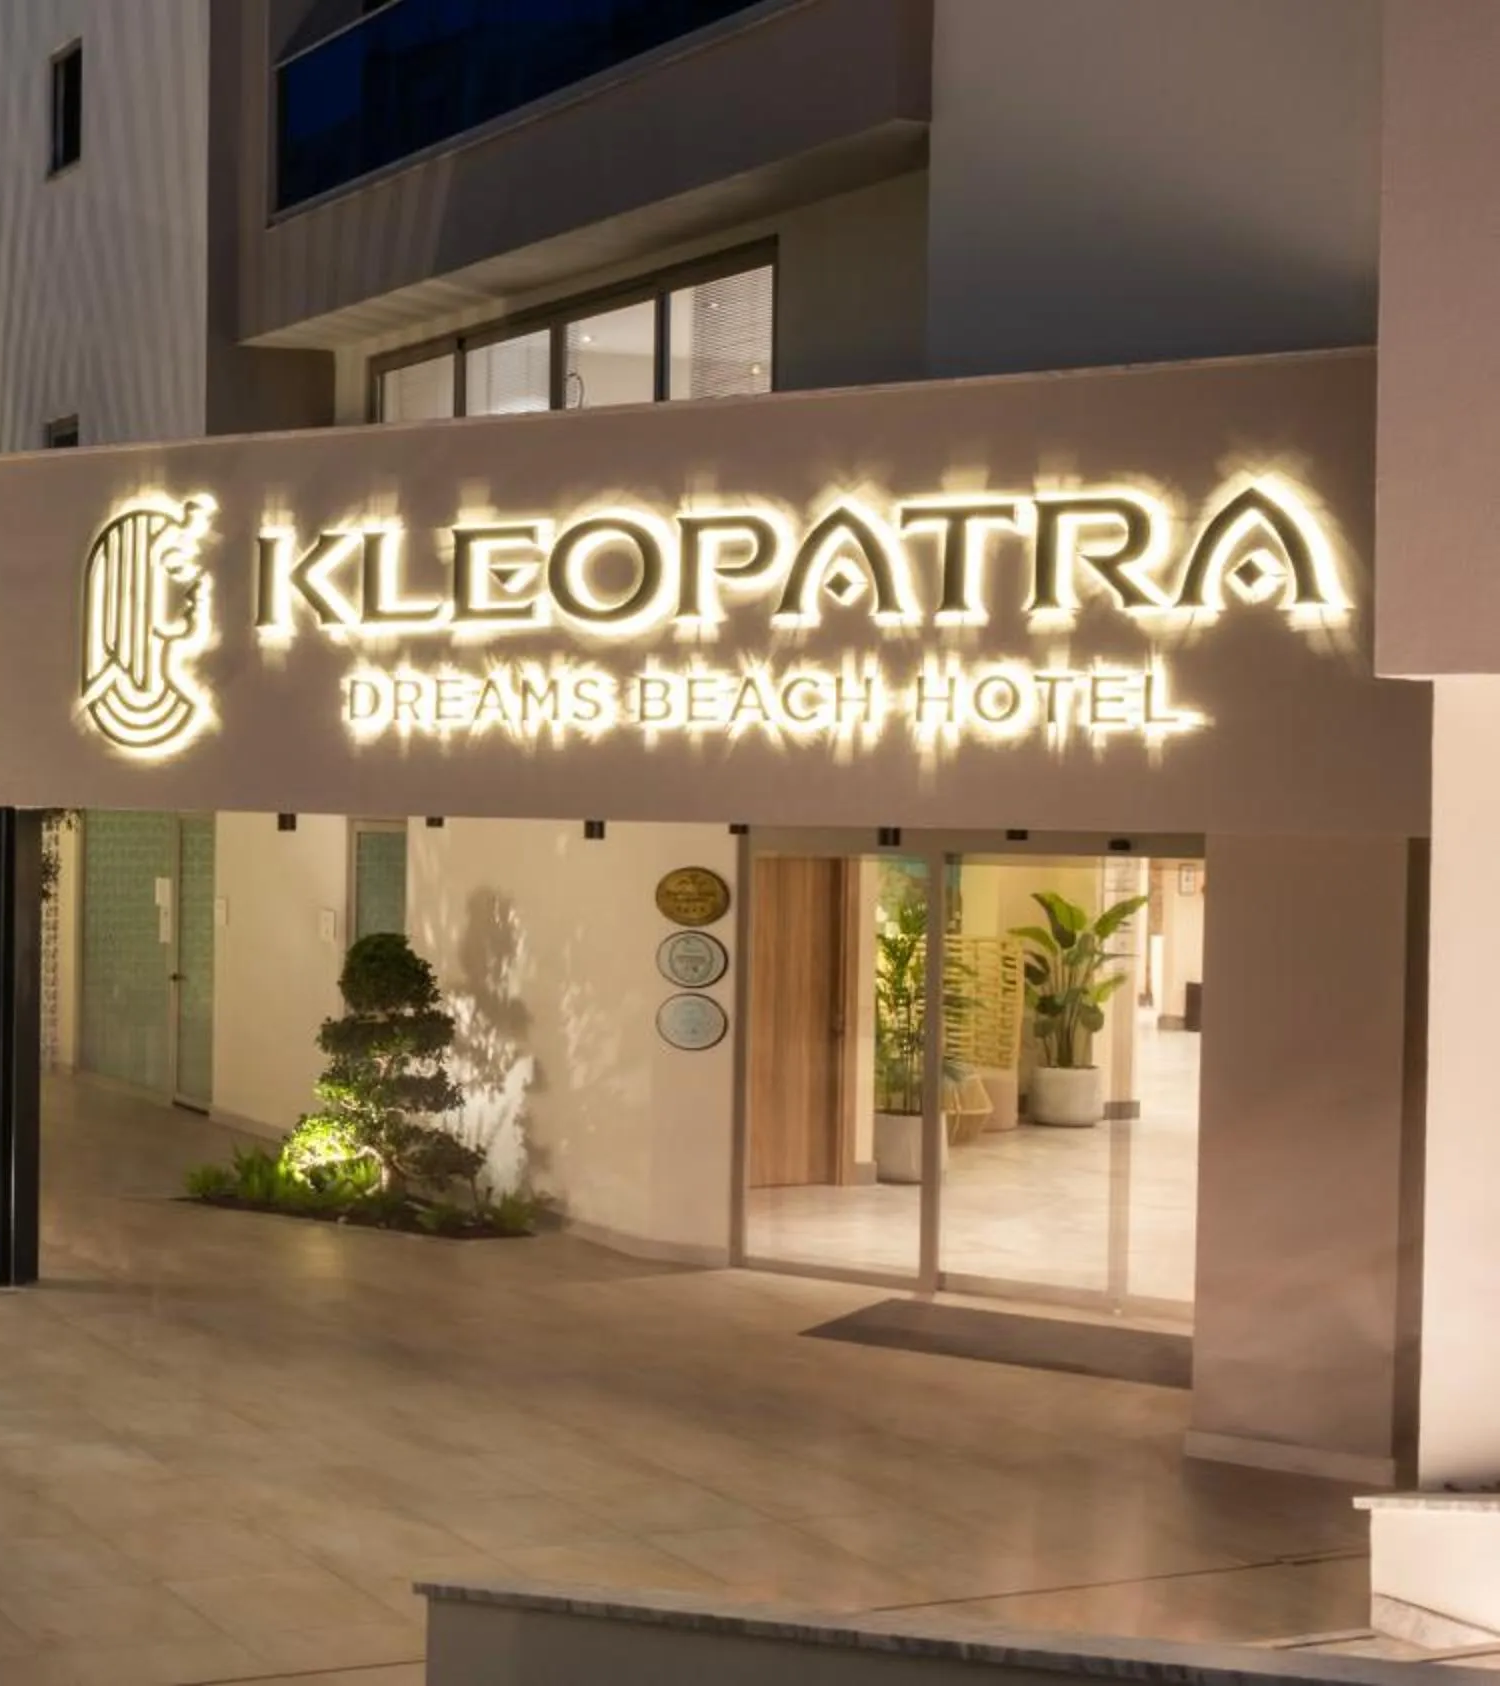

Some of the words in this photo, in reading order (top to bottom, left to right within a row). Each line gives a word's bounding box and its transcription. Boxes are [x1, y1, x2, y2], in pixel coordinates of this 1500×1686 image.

[254, 485, 1332, 628] KLEOPATRA
[347, 675, 604, 723] DREAMS
[636, 674, 877, 724] BEACH
[913, 673, 1180, 725] HOTEL
